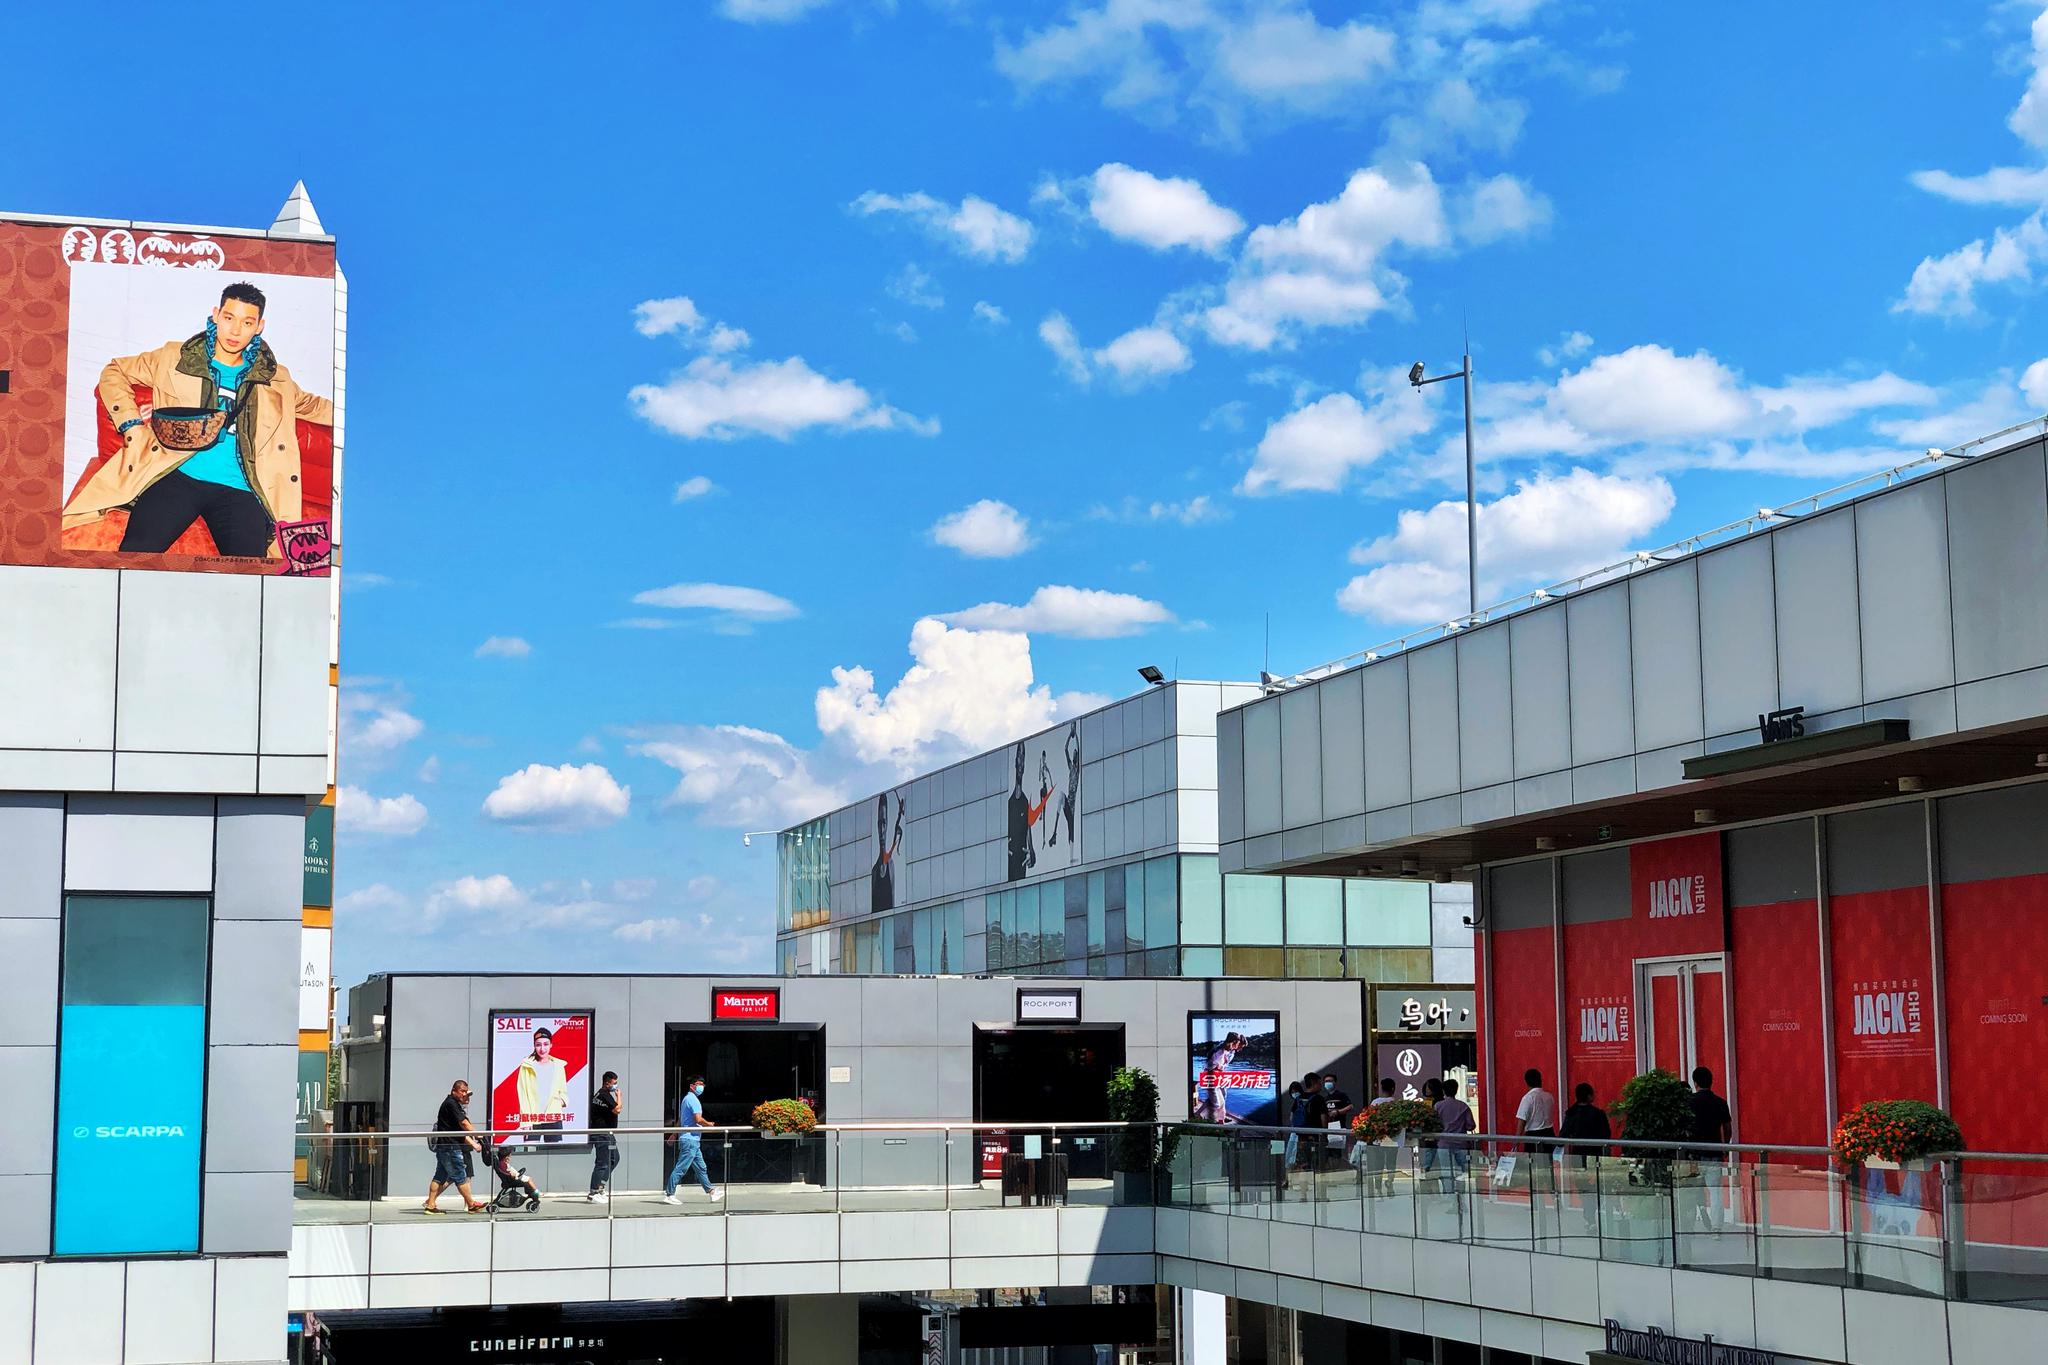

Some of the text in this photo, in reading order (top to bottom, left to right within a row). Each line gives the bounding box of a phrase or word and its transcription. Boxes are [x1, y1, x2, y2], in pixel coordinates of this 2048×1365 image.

[1759, 706, 1804, 744] VANS
[1649, 875, 1705, 918] JACK CHEN
[723, 996, 769, 1006] Marmot
[1023, 1000, 1073, 1008] ROCKPORT
[1854, 991, 1920, 1035] JACK CHEN
[1980, 1013, 2028, 1024] COMING SOON
[497, 1017, 532, 1030] SALE
[1581, 1007, 1629, 1042] JACK CHEN
[1201, 1074, 1271, 1089] 全场2折起
[95, 1125, 185, 1138] SCARPA
[470, 1335, 574, 1351] cuneiform
